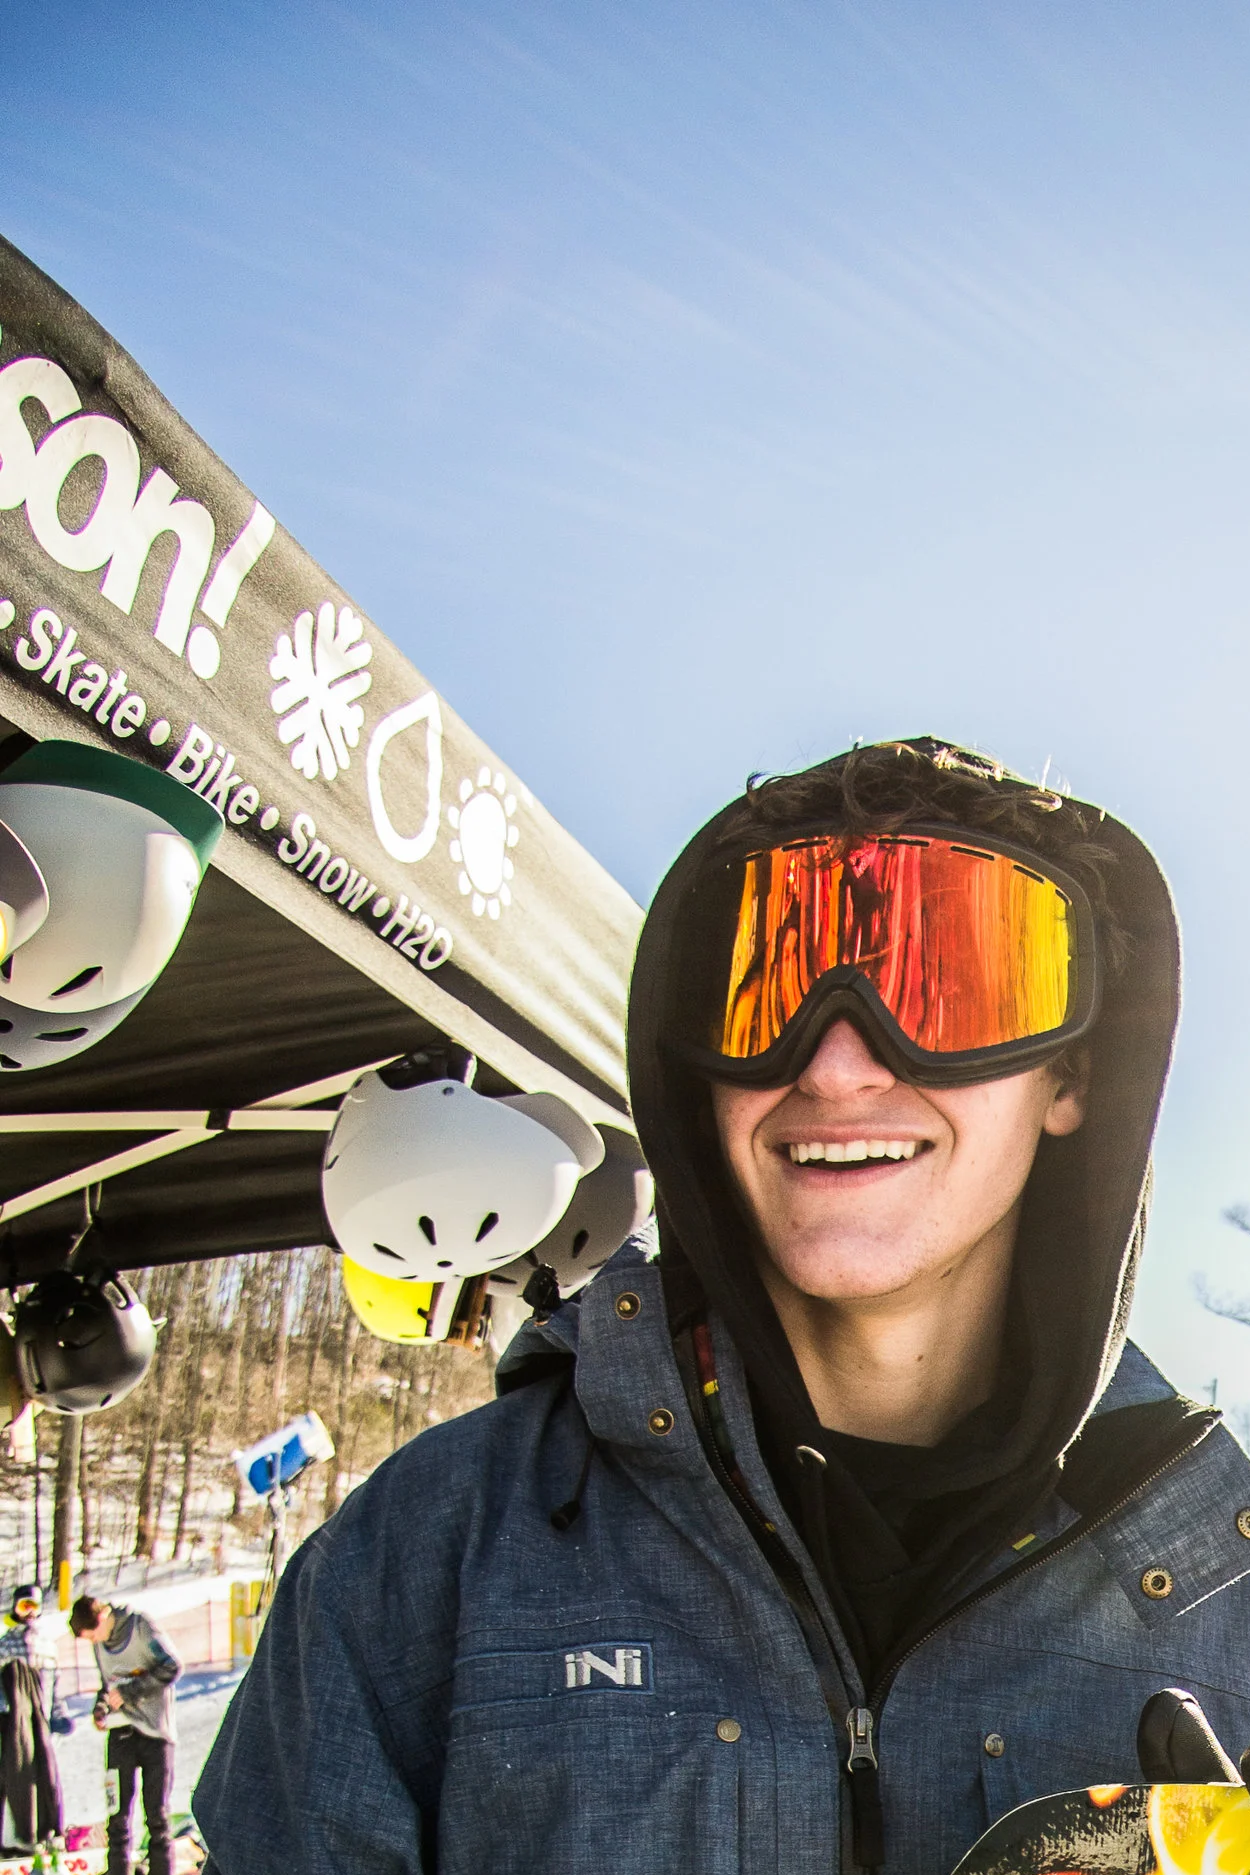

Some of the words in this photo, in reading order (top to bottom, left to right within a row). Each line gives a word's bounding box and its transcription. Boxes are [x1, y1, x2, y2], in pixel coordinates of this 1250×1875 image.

[16, 608, 146, 738] Skate
[166, 722, 260, 825] Bike
[278, 812, 377, 913] Snow
